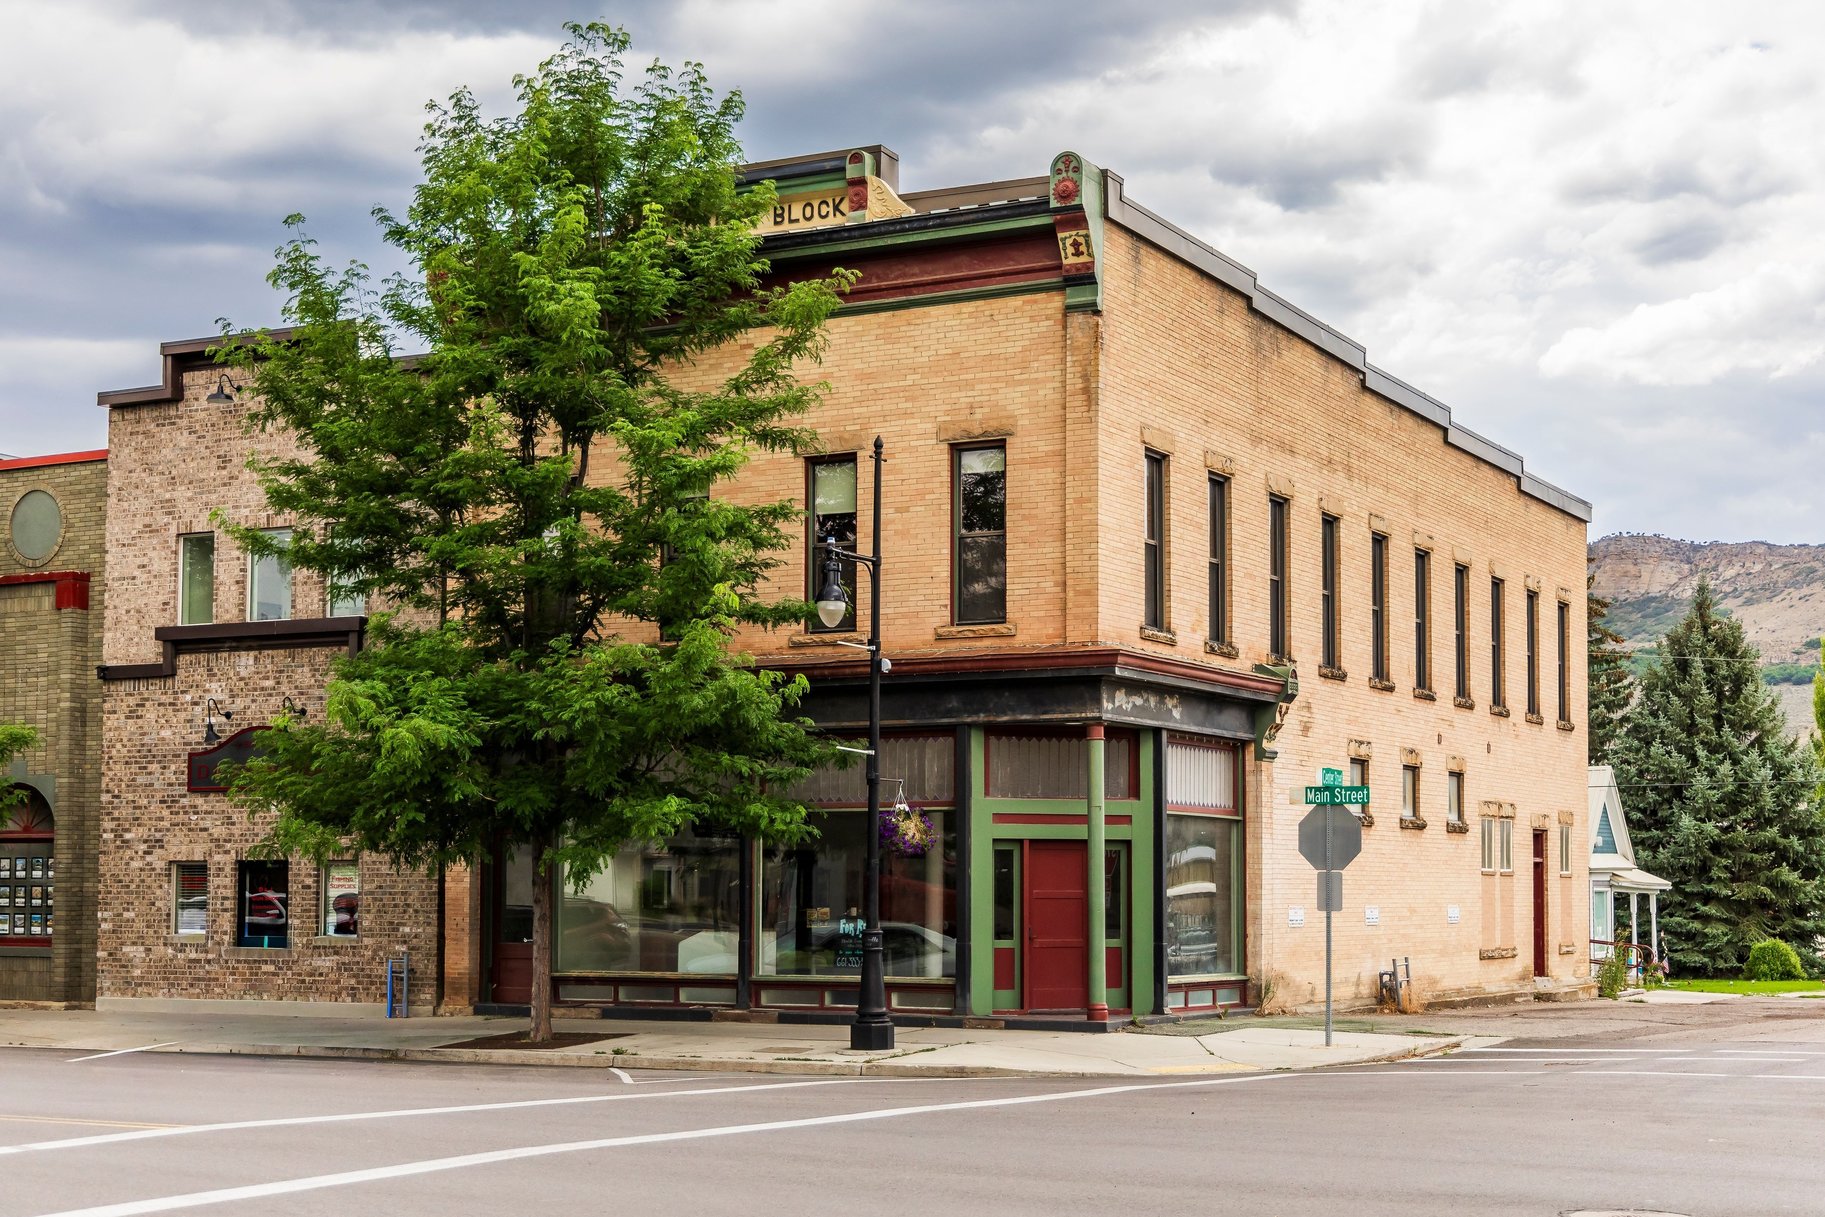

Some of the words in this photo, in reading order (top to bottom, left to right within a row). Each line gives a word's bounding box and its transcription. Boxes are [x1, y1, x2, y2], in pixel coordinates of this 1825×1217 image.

[773, 196, 847, 226] BLOCK
[1307, 788, 1330, 803] Main
[1334, 788, 1368, 803] Street
